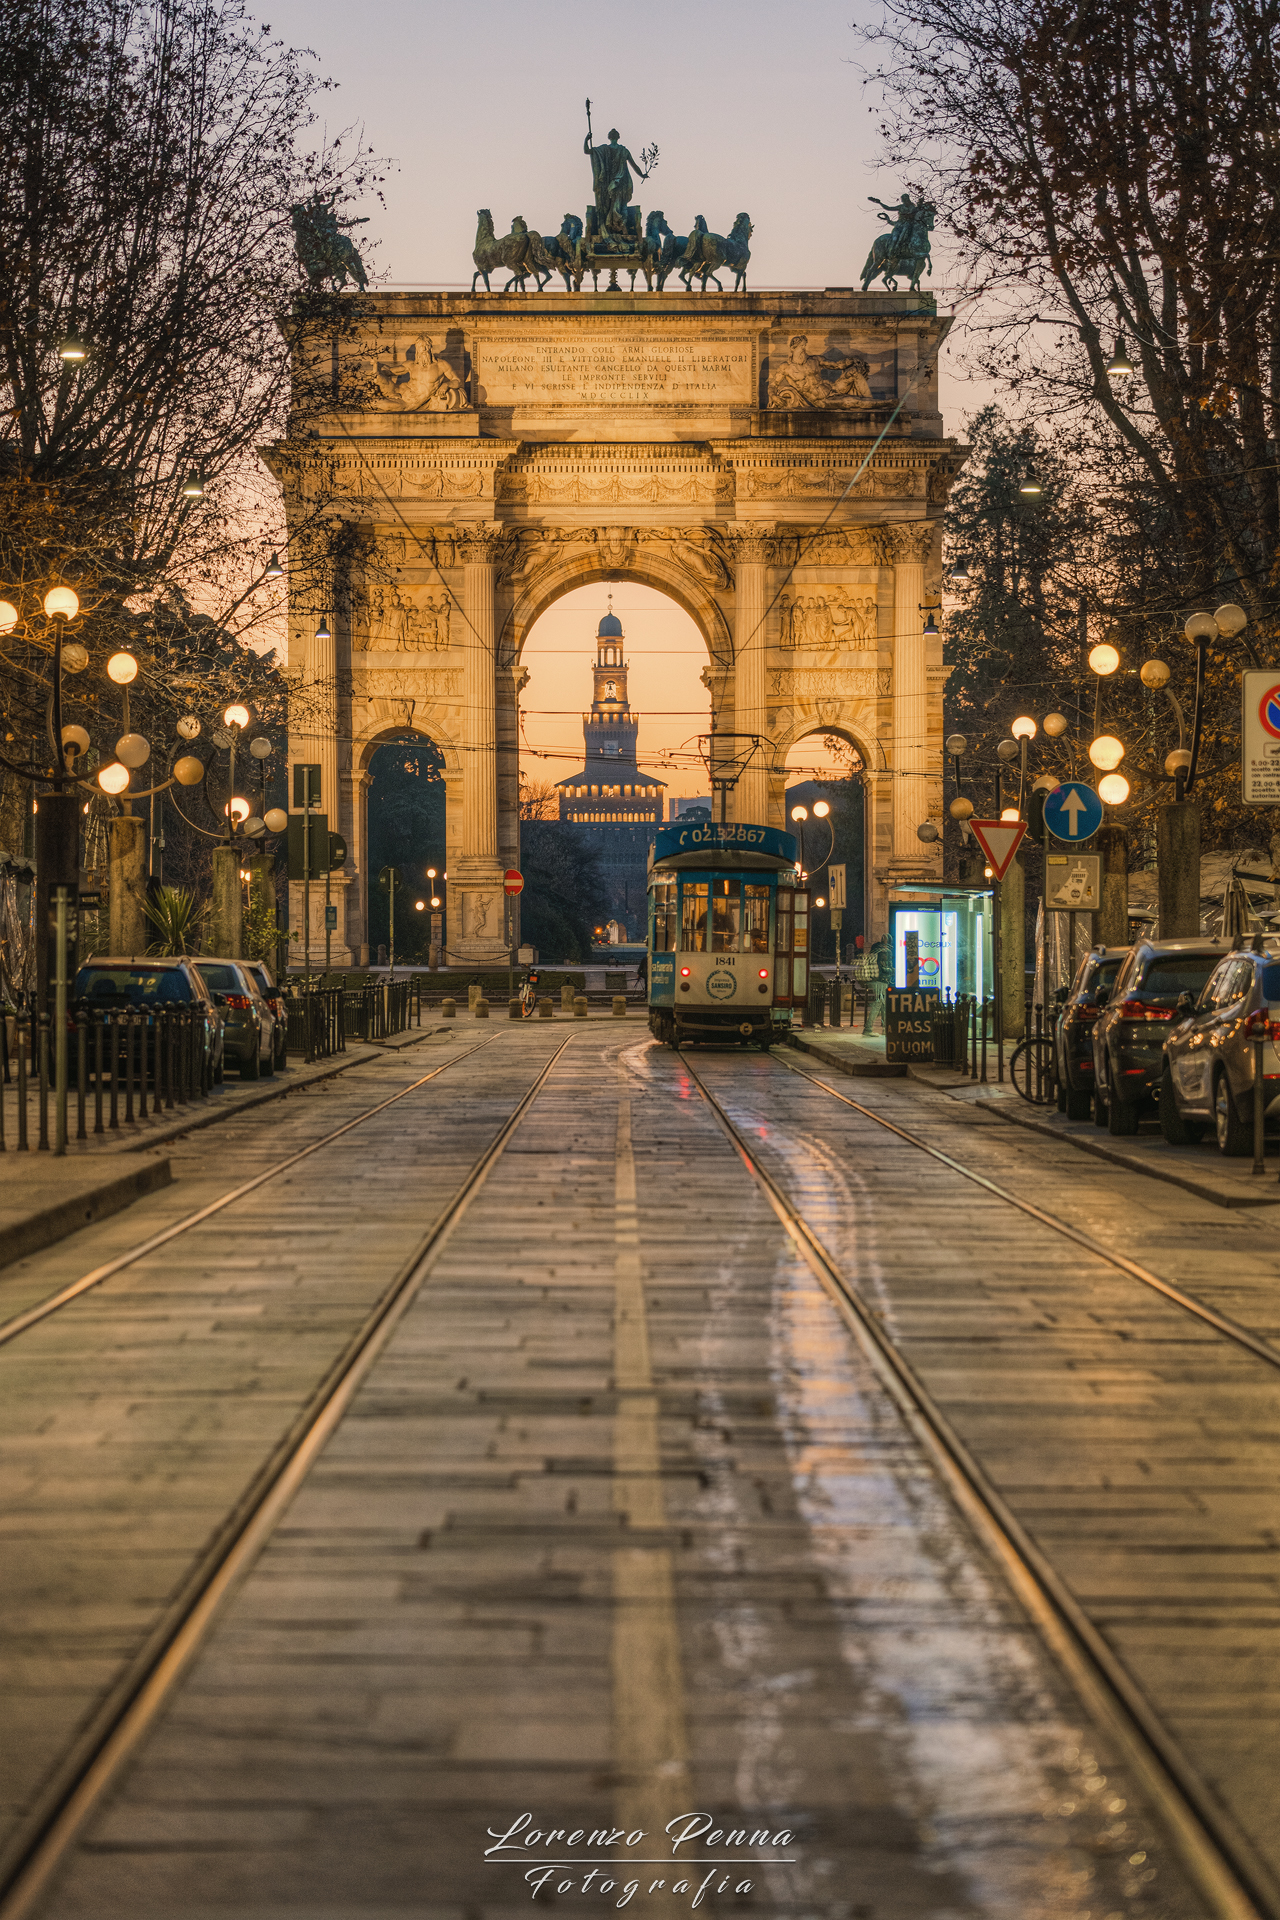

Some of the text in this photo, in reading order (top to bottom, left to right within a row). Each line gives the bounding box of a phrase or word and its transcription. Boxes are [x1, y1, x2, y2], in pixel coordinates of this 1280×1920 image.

[651, 346, 694, 354] GLORIOSE
[482, 355, 747, 363] NAPOLEONE III E VITTORIO EMANUELE II LIBERATORI
[647, 364, 658, 372] DA
[664, 364, 696, 372] QUESTI
[702, 364, 732, 372] MARMI
[541, 383, 576, 391] SCRISSE
[692, 829, 766, 843] 02.32867
[715, 956, 736, 966] 1841
[888, 994, 938, 1013] TRAM
